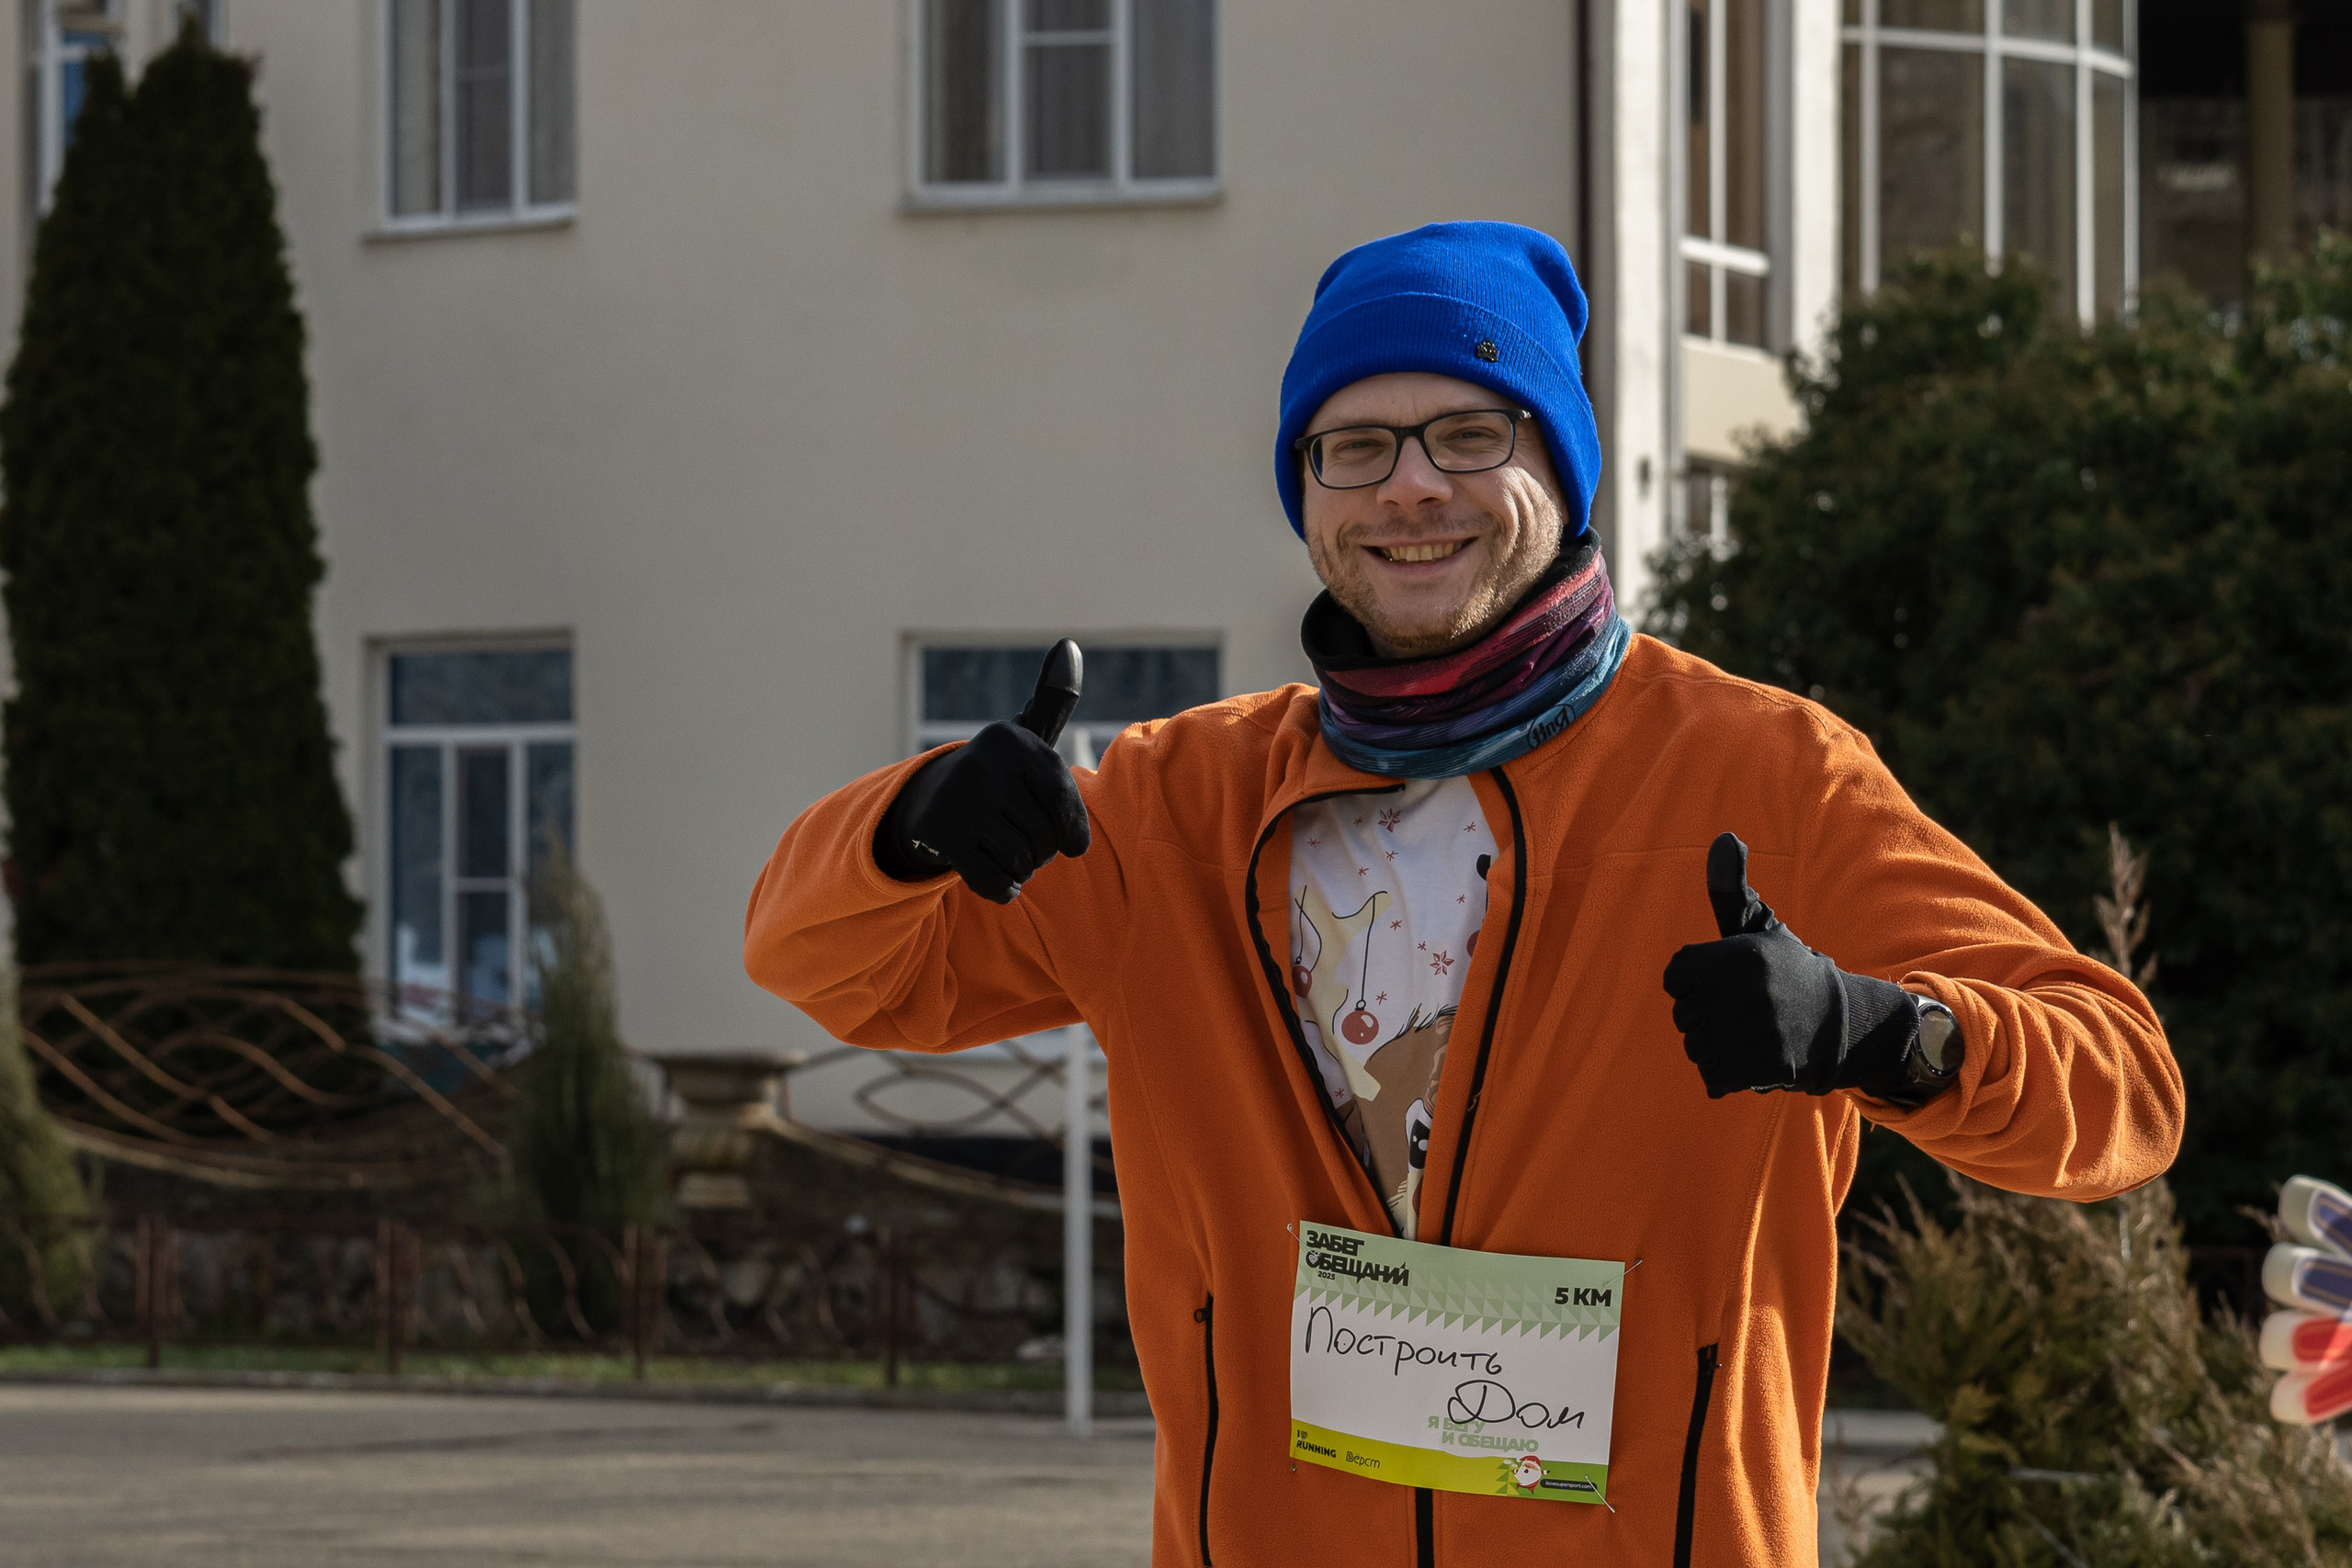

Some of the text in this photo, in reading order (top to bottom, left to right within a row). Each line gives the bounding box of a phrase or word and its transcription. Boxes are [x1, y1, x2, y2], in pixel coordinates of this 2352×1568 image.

[1306, 1230, 1364, 1257] ЗАБЕГ
[1306, 1249, 1410, 1287] ОБЕЩАНИЙ
[1317, 1270, 1336, 1280] 2025
[1555, 1287, 1569, 1304] 5
[1305, 1305, 1503, 1377] Построить
[1447, 1379, 1586, 1429] Дом
[1427, 1416, 1440, 1429] Я
[1296, 1439, 1337, 1459] RUNNING
[1442, 1432, 1540, 1453] И ОБЕЩАЮ
